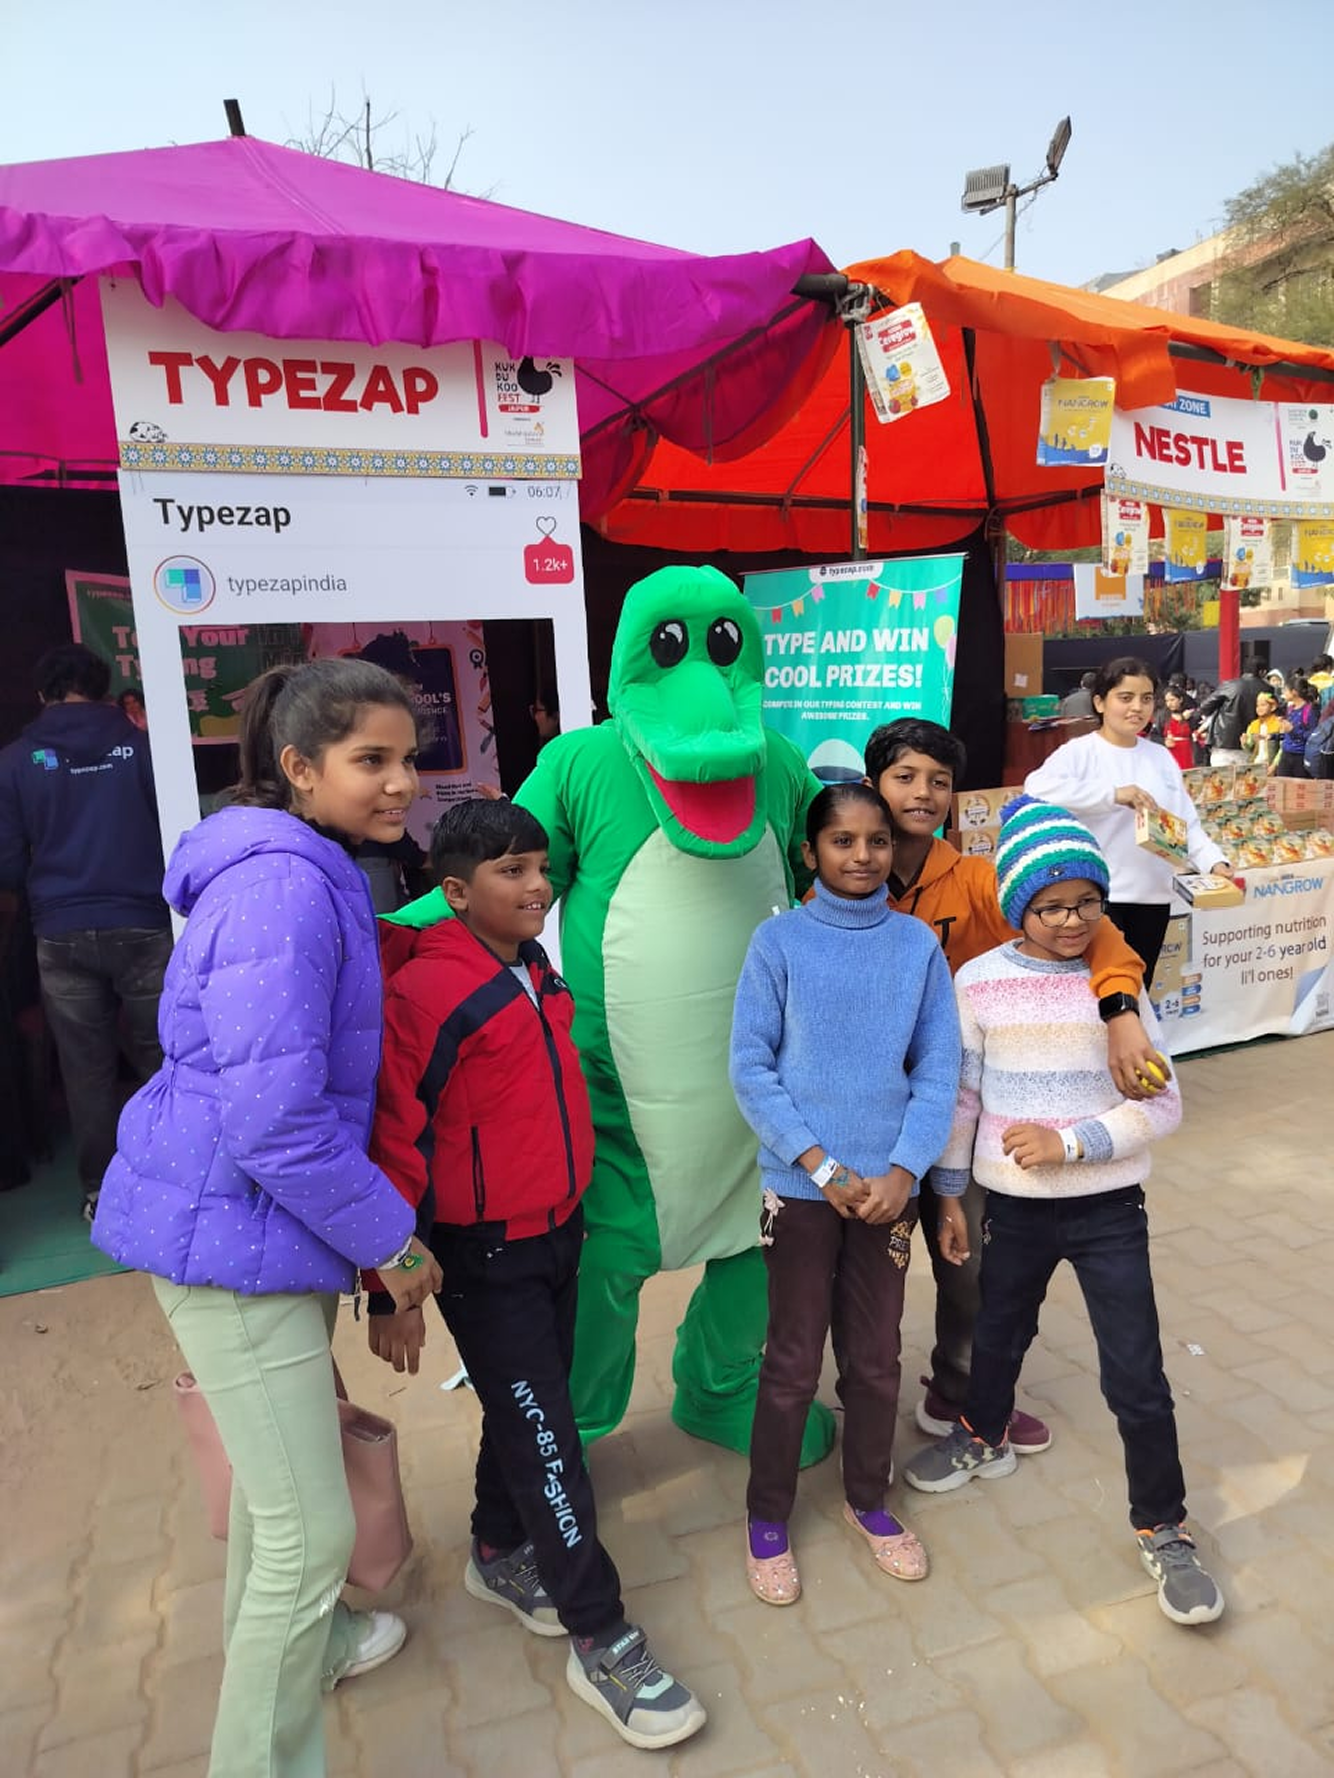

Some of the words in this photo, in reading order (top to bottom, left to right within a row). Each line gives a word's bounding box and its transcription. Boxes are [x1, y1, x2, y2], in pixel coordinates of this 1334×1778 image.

[148, 351, 439, 415] TYPEZAP
[496, 382, 519, 392] KOO
[1179, 398, 1209, 415] ZONE
[1134, 421, 1247, 474] NESTLE
[527, 486, 560, 498] 06:07
[153, 497, 292, 533] Typezap
[532, 557, 568, 572] 1.2k+
[228, 576, 347, 596] typezapindia
[183, 627, 249, 647] Your
[764, 631, 815, 656] TYPE
[820, 630, 867, 654] AND
[872, 627, 929, 652] WIN
[764, 665, 822, 689] COOL
[826, 664, 923, 688] PRIZES!
[413, 691, 452, 704] OOL'S
[1254, 878, 1324, 898] NANGROW
[1202, 925, 1271, 946] Supporting
[1275, 916, 1327, 934] nutrition
[1203, 953, 1222, 968] for
[1224, 951, 1252, 969] your
[1255, 944, 1276, 960] 2-6
[1257, 967, 1294, 982] ones!
[511, 1380, 559, 1457] NYC-85
